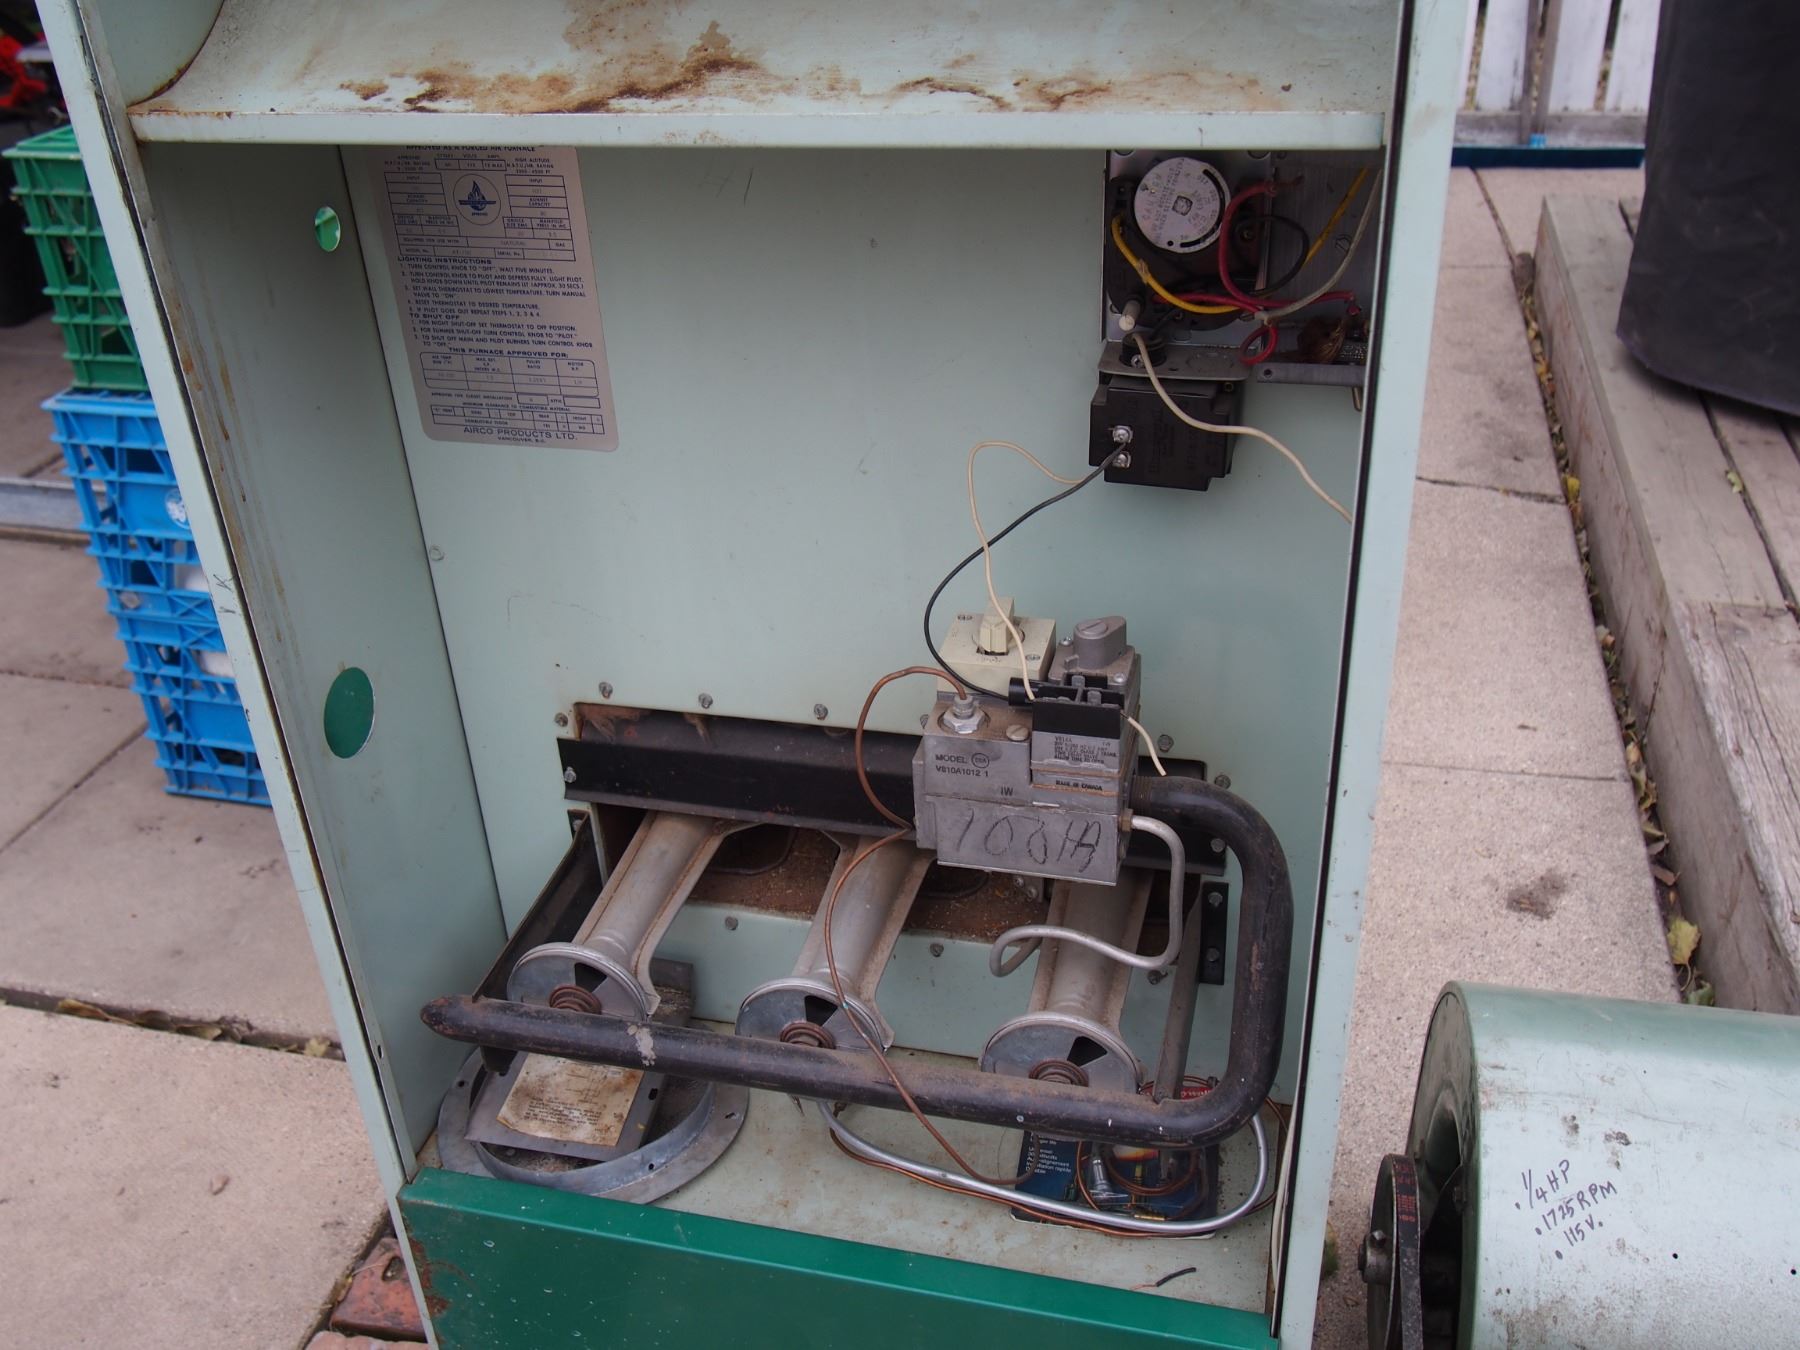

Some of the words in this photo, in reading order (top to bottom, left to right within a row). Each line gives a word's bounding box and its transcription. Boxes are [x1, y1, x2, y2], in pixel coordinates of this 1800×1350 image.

[463, 427, 493, 435] AIRCO
[496, 429, 551, 438] PRODUCTS
[935, 753, 968, 764] MODEL
[1000, 785, 1014, 797] IW
